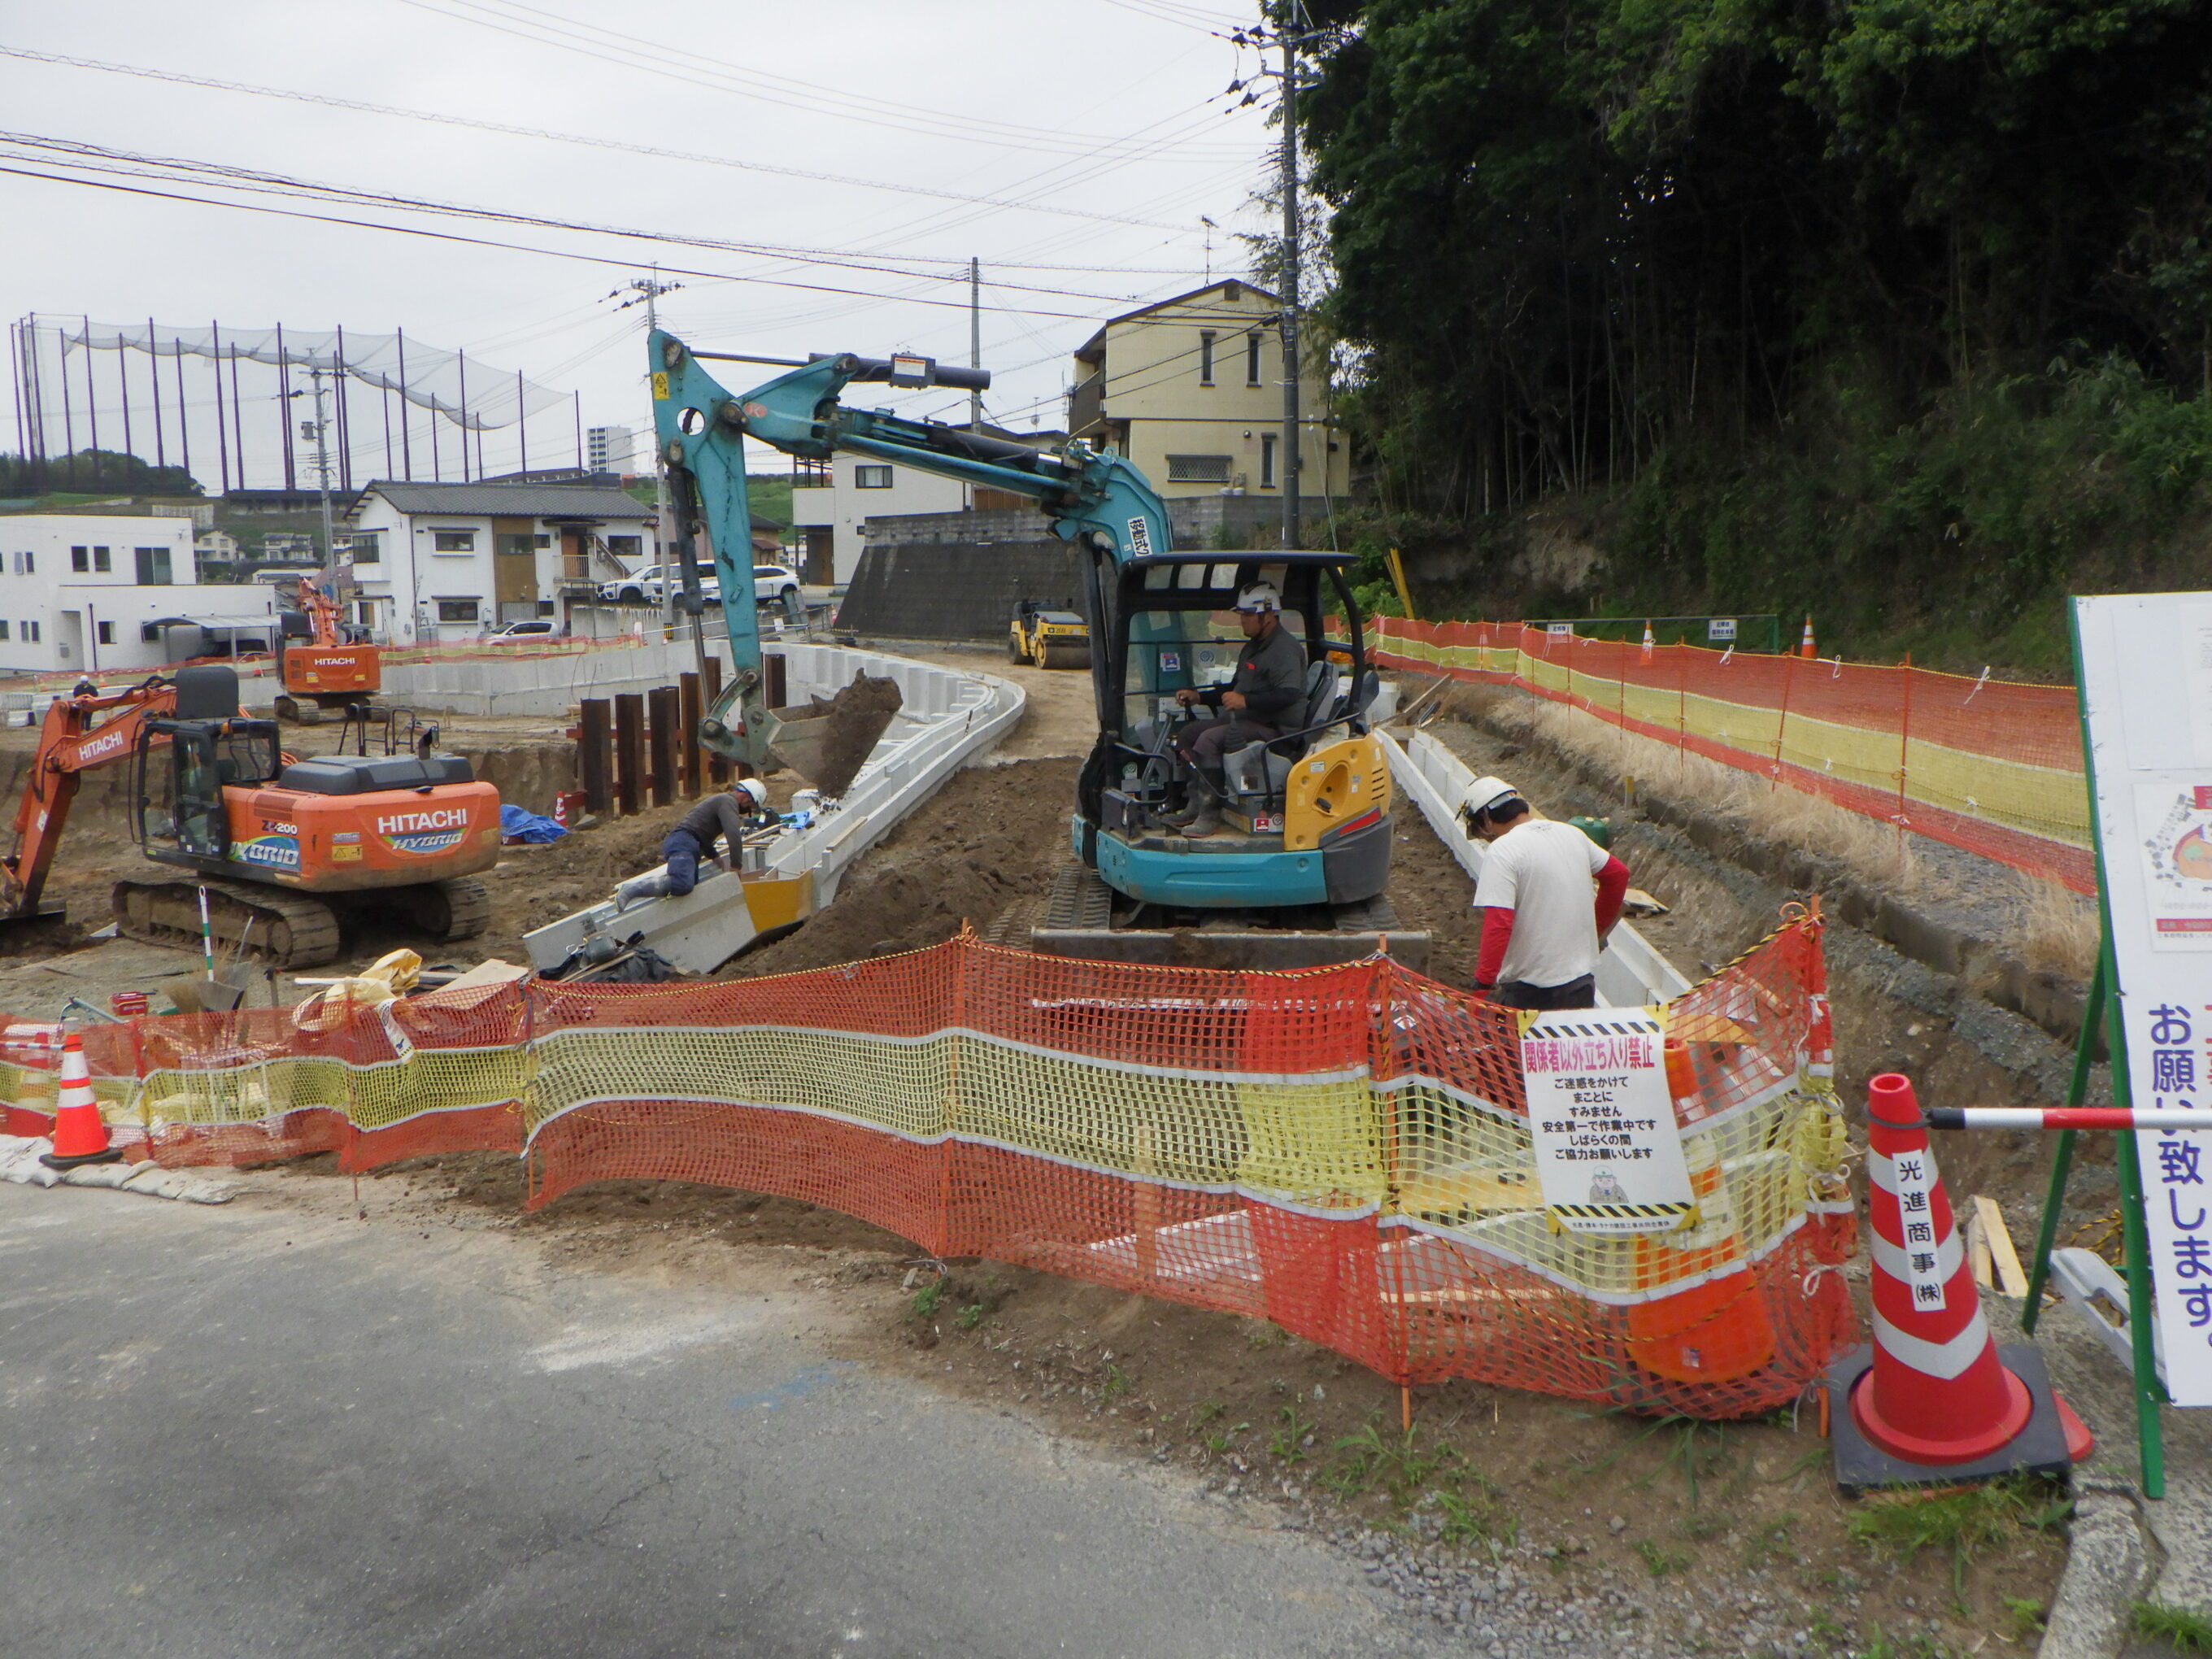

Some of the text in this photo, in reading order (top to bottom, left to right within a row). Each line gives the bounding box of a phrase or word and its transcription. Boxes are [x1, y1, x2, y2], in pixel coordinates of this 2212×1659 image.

[314, 657, 355, 665] HITACHI
[79, 730, 123, 760] HITACHI
[377, 808, 468, 834] HITACHI
[392, 832, 464, 850] HYBRID
[1524, 1035, 1655, 1073] 関係者以外立ち入り禁止
[1554, 1076, 1629, 1089] ご迷惑をかけて
[1573, 1091, 1613, 1104] まことに
[1569, 1106, 1622, 1117] すみません
[1542, 1119, 1657, 1133] 安全第一で作業中です
[1570, 1134, 1632, 1147] しばらくの間
[1555, 1147, 1653, 1160] ご協力お願いします
[2149, 1004, 2212, 1347] お願致します
